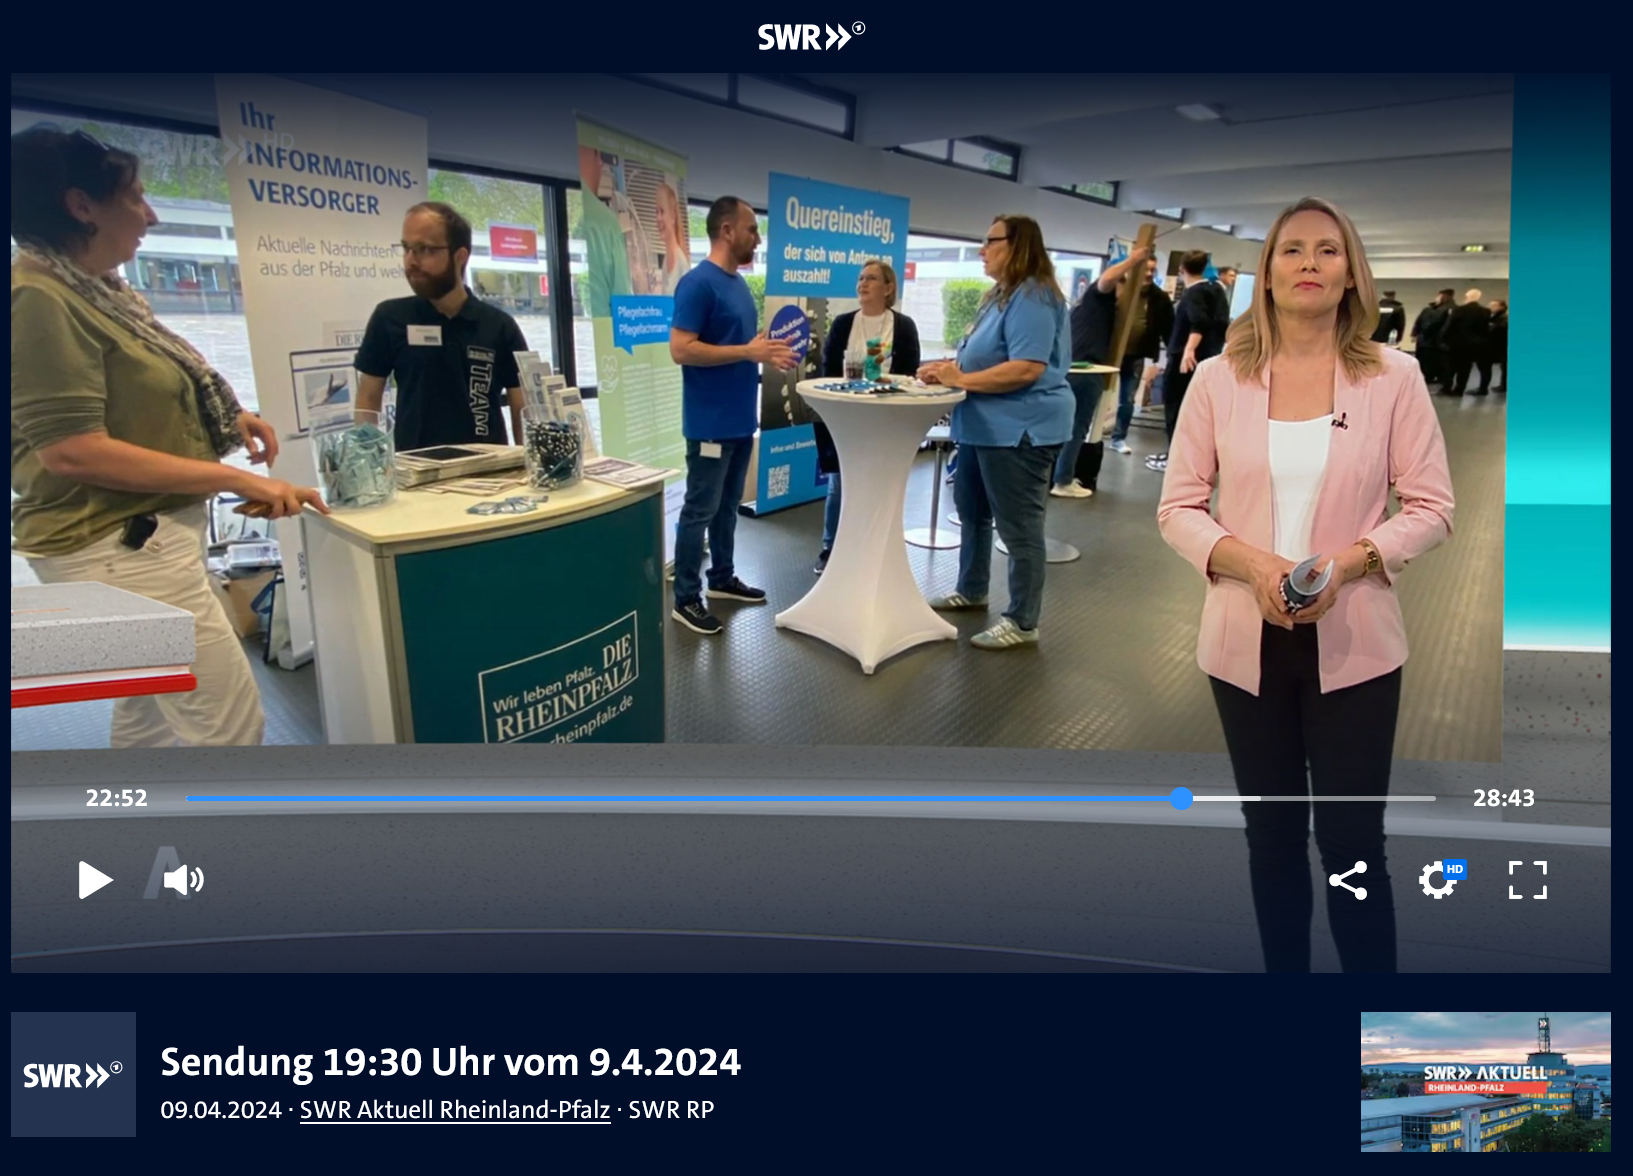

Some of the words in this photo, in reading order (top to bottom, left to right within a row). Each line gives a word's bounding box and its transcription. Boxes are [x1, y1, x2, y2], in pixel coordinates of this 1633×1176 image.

[240, 102, 275, 131] Ihr
[246, 141, 418, 190] INFORMATIONS-
[248, 178, 380, 215] VERSORGER
[786, 196, 895, 244] Quereinstieg,
[257, 235, 316, 256] Aktuelle
[321, 240, 394, 259] Nachrichten
[784, 243, 802, 261] der
[804, 245, 826, 263] sich
[828, 250, 846, 265] von
[260, 260, 288, 277] aus
[293, 258, 315, 278] der
[320, 261, 350, 279] Pfalz
[353, 263, 377, 279] und
[783, 268, 831, 284] auszahlt!
[602, 634, 632, 670] DIE
[493, 695, 520, 714] Wir
[523, 681, 562, 704] leben
[565, 666, 596, 687] Pfalz.
[495, 658, 633, 742] RHEINPFALZ
